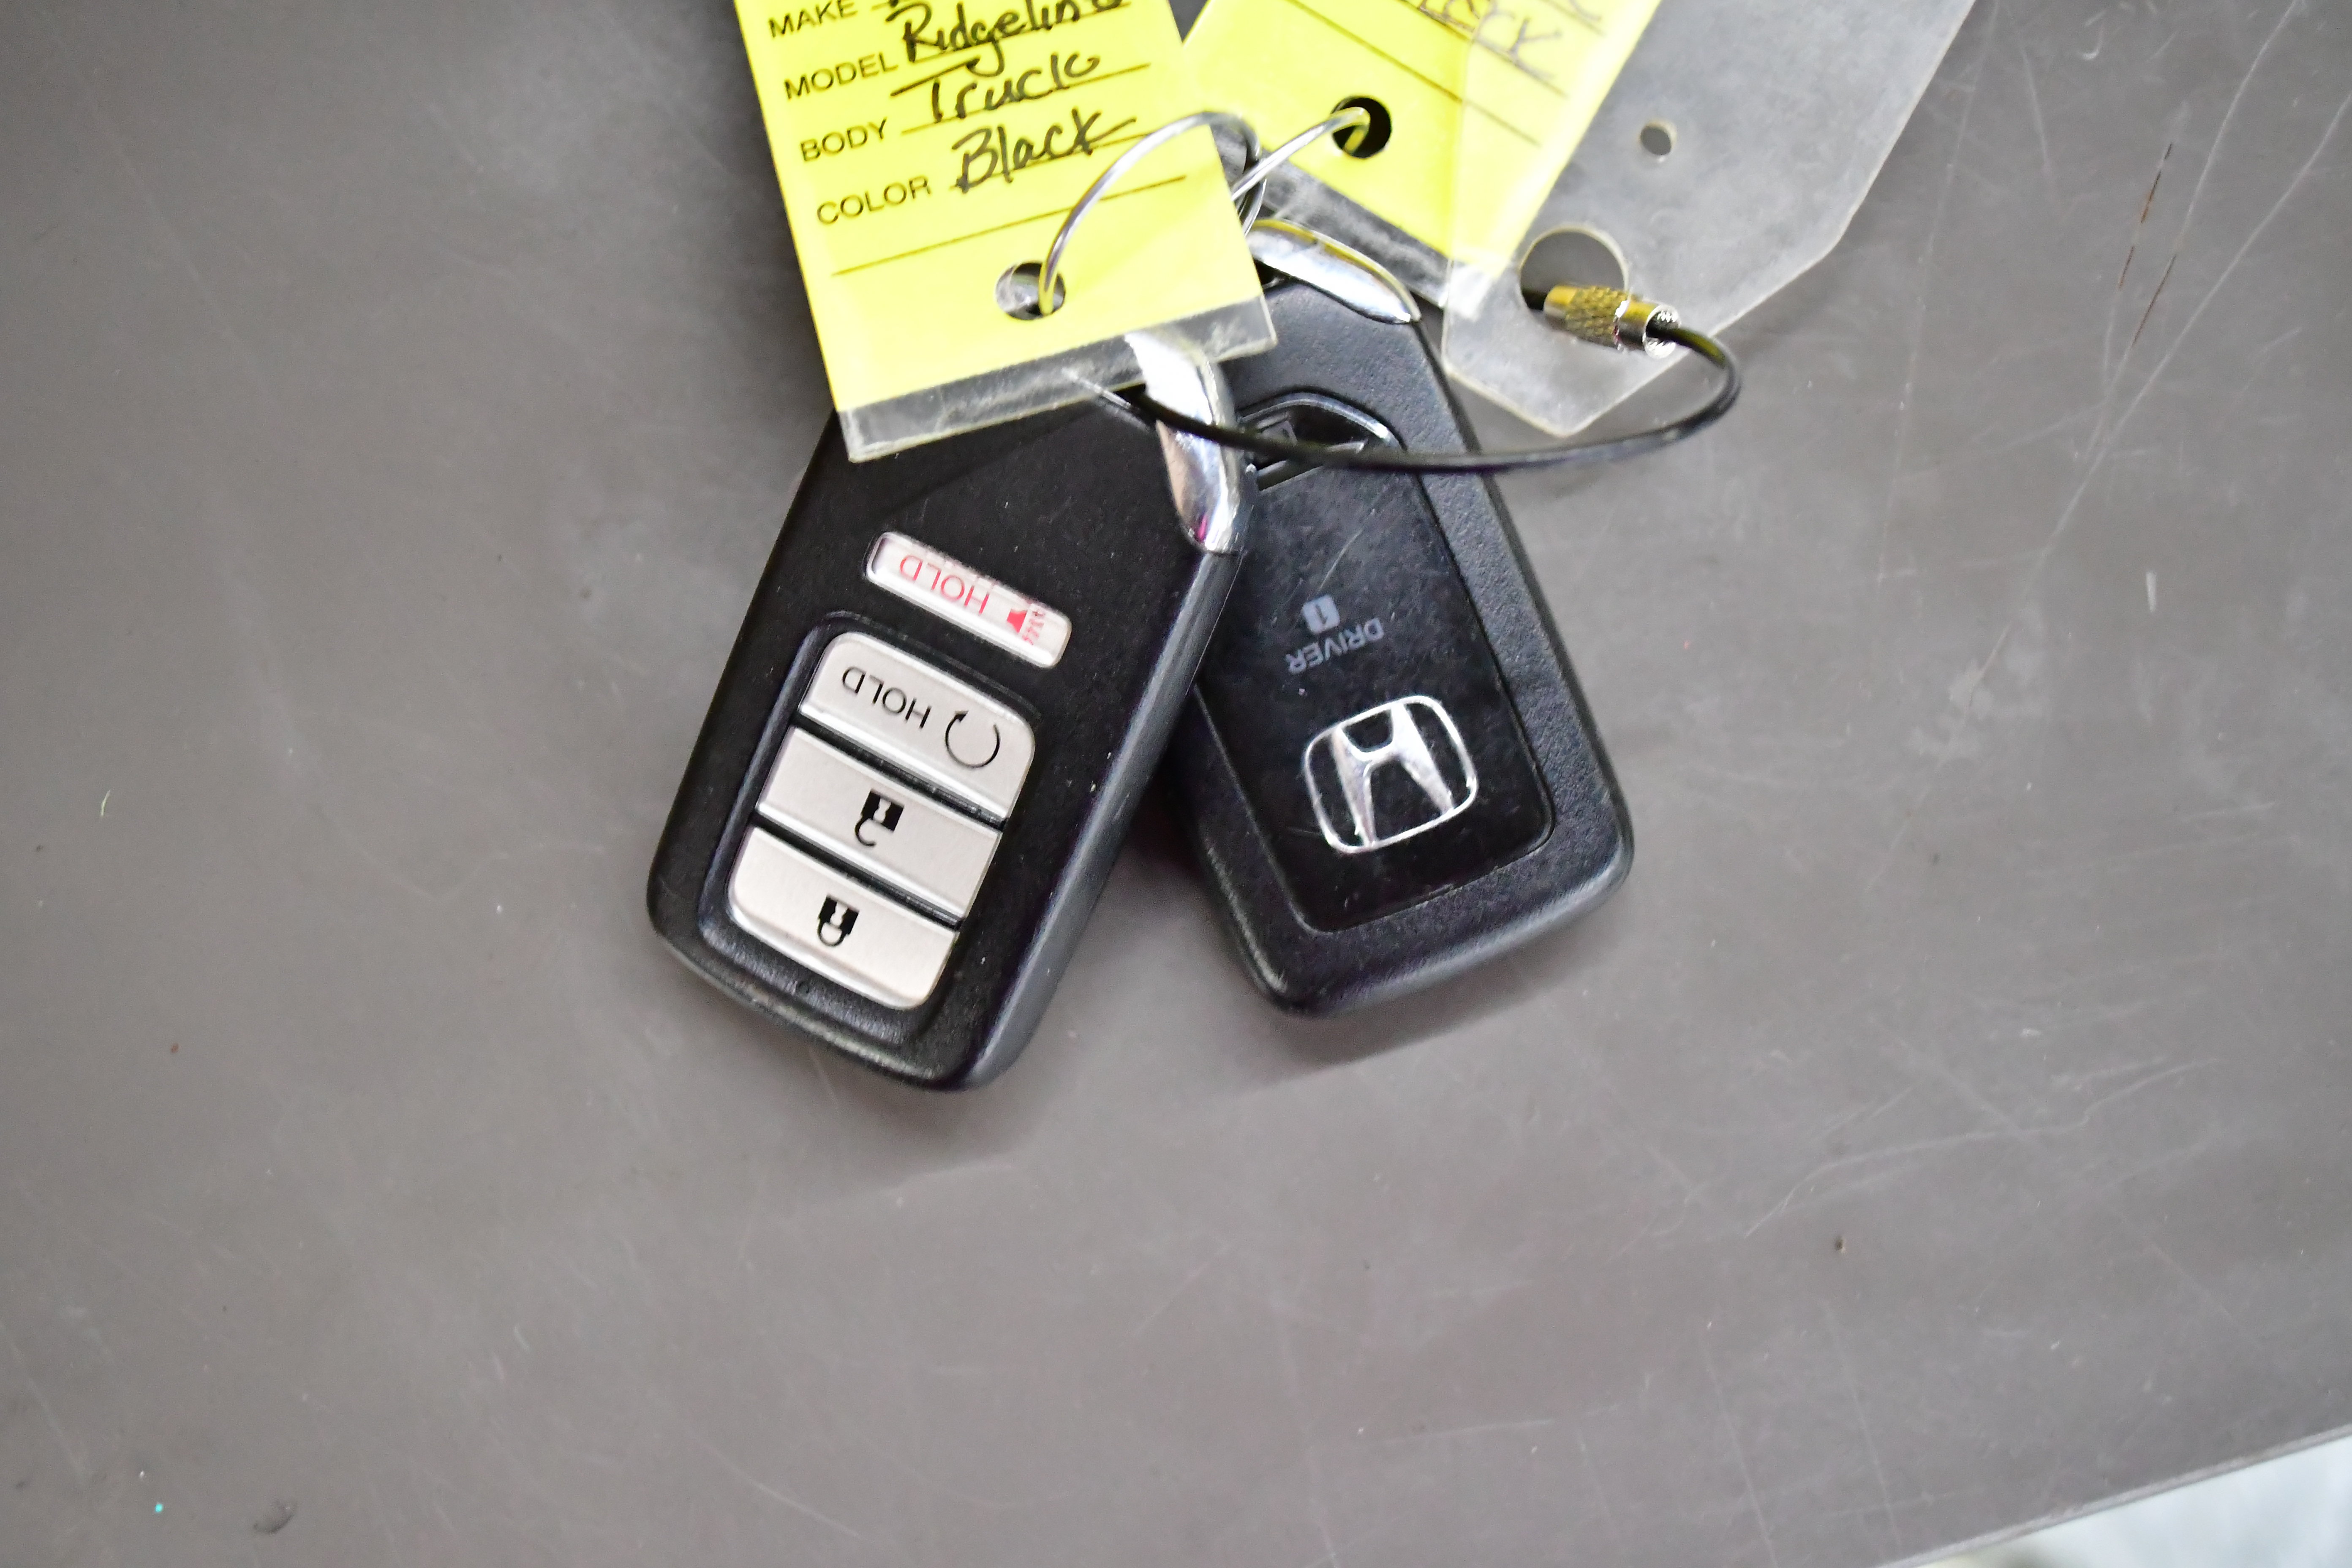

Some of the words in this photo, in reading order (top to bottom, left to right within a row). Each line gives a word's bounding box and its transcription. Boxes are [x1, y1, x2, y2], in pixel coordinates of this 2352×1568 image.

[768, 0, 858, 38] MAKE
[784, 53, 898, 99] MODEL
[800, 119, 888, 162] BODY
[952, 108, 1136, 193] Black
[817, 177, 931, 224] COLOR
[900, 555, 989, 614] HOLD
[1285, 618, 1384, 674] DRIVER
[842, 667, 932, 728] HOLD
